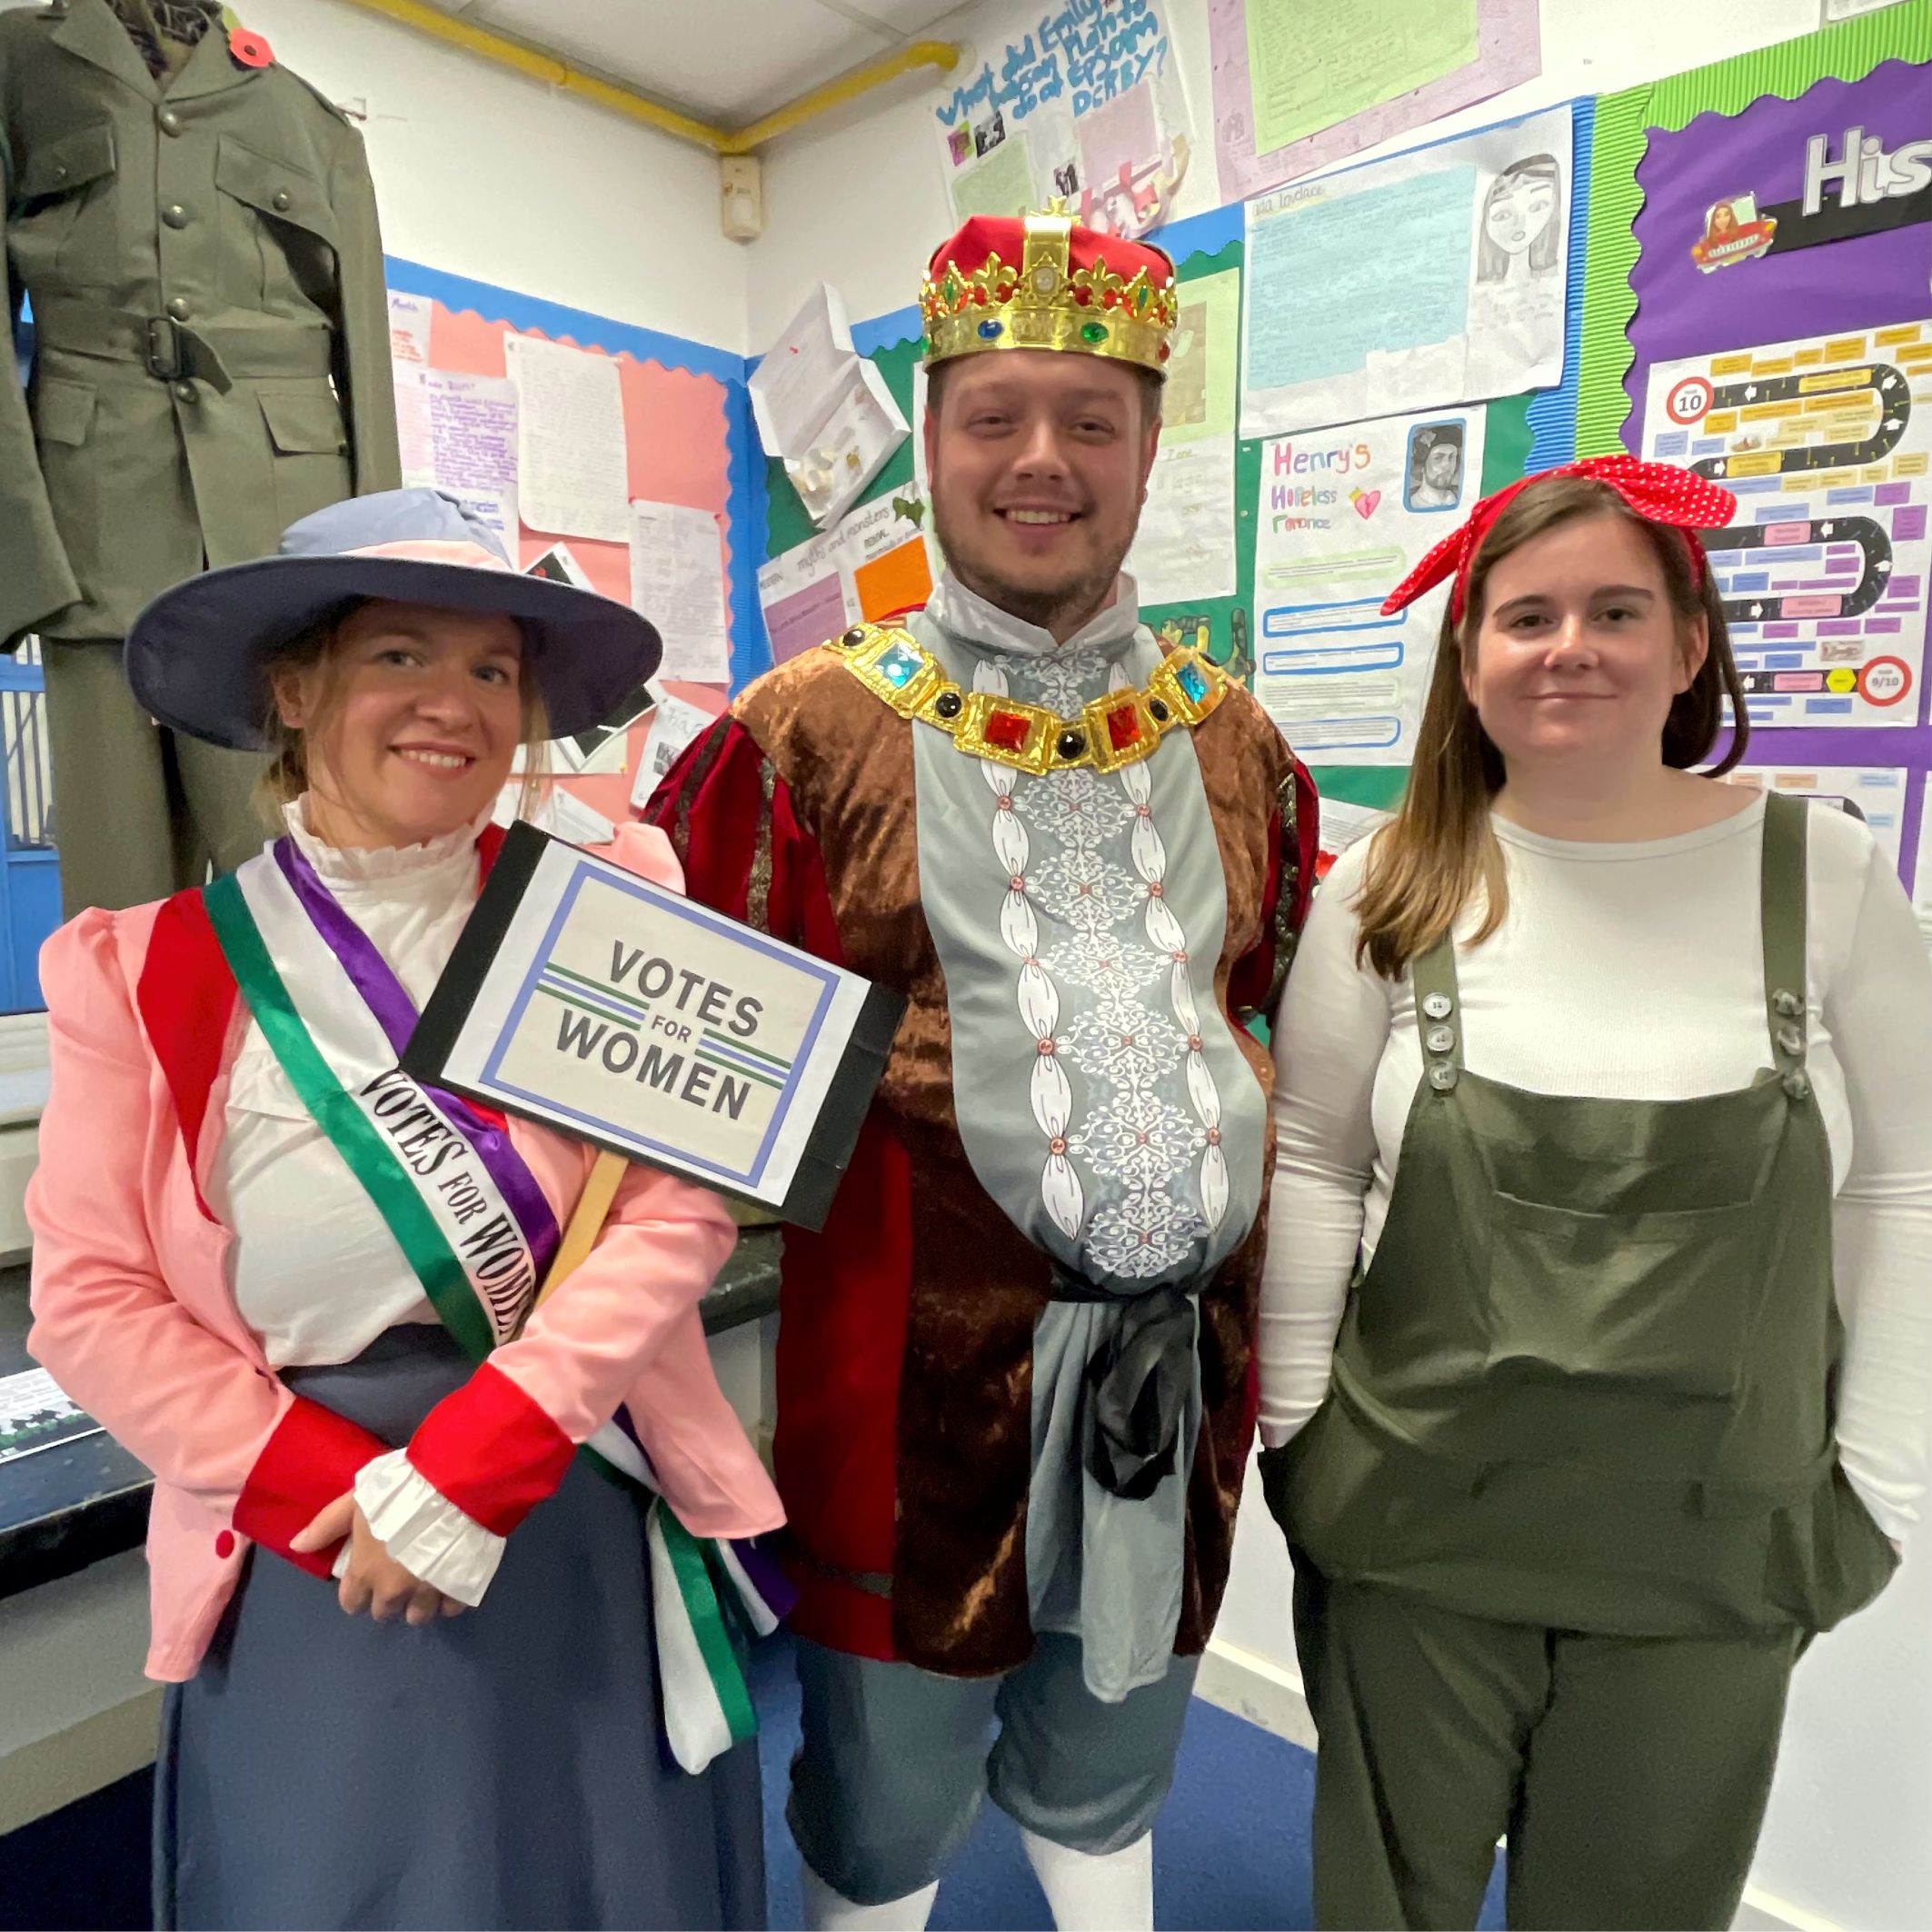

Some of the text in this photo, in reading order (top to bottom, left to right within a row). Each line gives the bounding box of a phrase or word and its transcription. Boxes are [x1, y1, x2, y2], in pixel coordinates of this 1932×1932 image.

[1678, 394, 1702, 413] 10
[610, 939, 764, 1037] VOTES
[651, 1013, 692, 1043] FOR
[556, 1008, 752, 1120] WOMEN
[360, 1067, 469, 1176] VOTES
[438, 1170, 488, 1225] FOR
